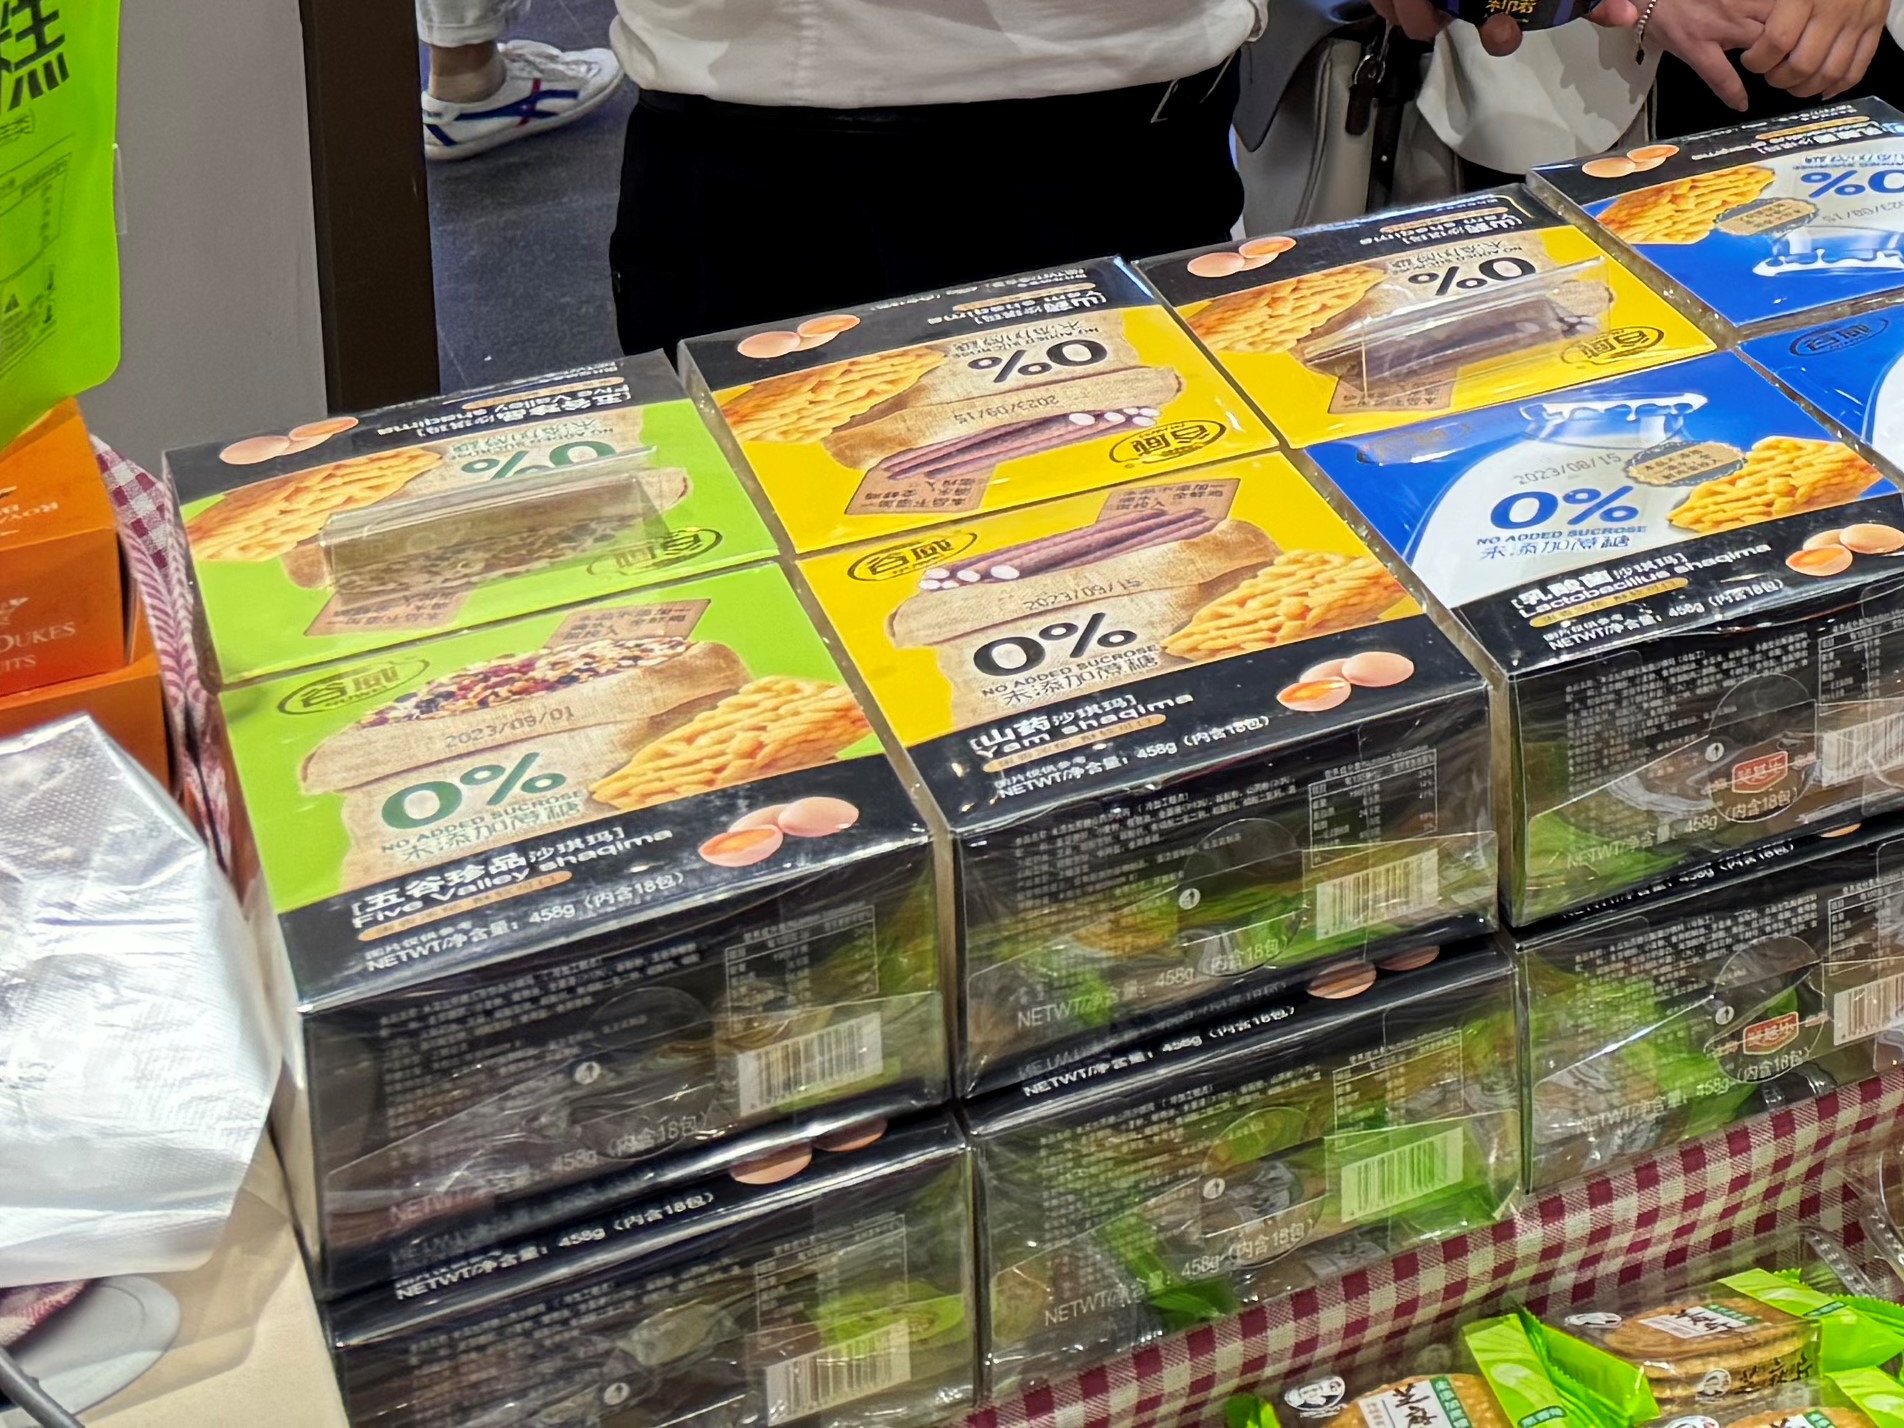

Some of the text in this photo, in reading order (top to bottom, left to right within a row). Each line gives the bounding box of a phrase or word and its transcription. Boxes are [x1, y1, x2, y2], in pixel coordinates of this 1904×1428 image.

[1407, 256, 1537, 296] 0%
[966, 339, 1108, 384] 0%
[1512, 452, 1623, 485] 2023/08/15
[1490, 485, 1639, 530] 0%
[973, 612, 1138, 676] 0%
[382, 752, 566, 829] 0%
